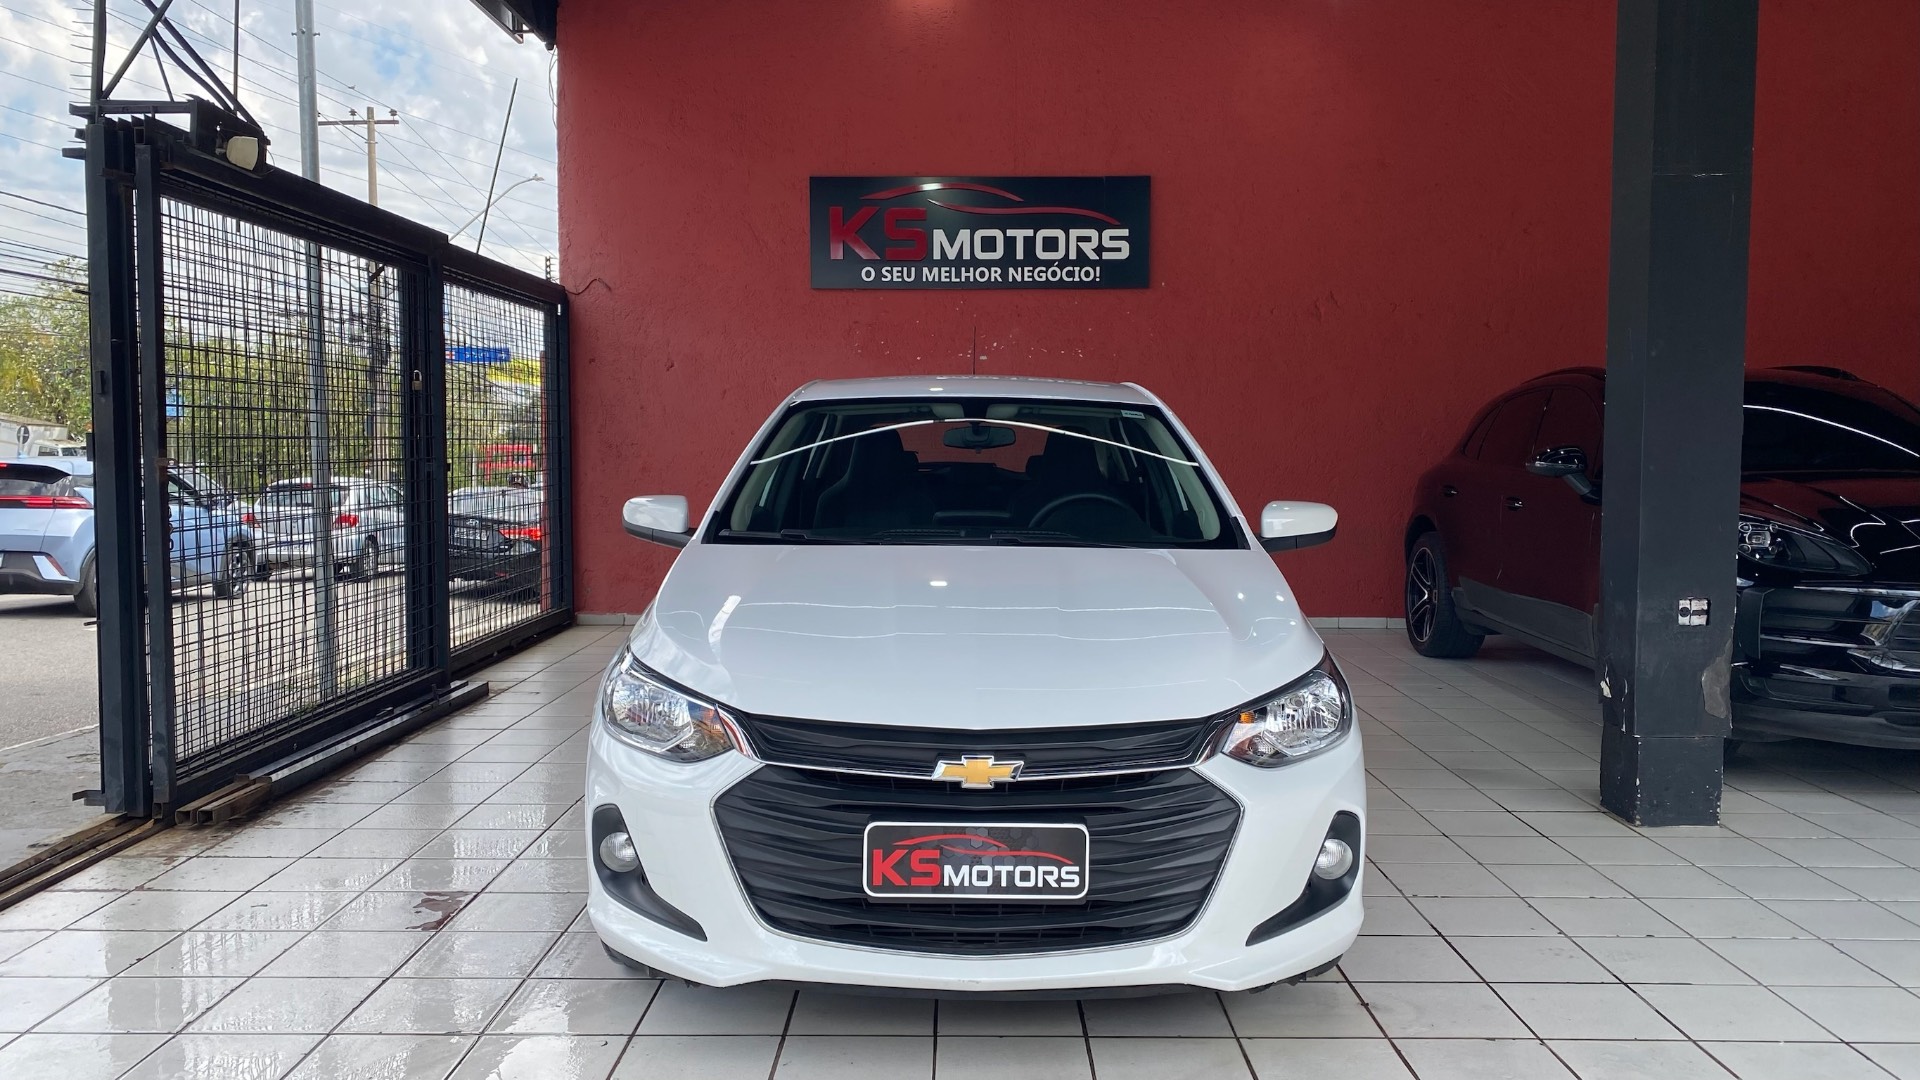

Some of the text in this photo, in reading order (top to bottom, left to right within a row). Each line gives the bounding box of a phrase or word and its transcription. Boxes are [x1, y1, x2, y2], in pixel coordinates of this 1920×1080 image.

[829, 207, 1130, 261] KS MOTORS
[861, 262, 1100, 282] O SEU MELHOR NEGÓCIO!
[872, 849, 1080, 887] KS MOTORS
